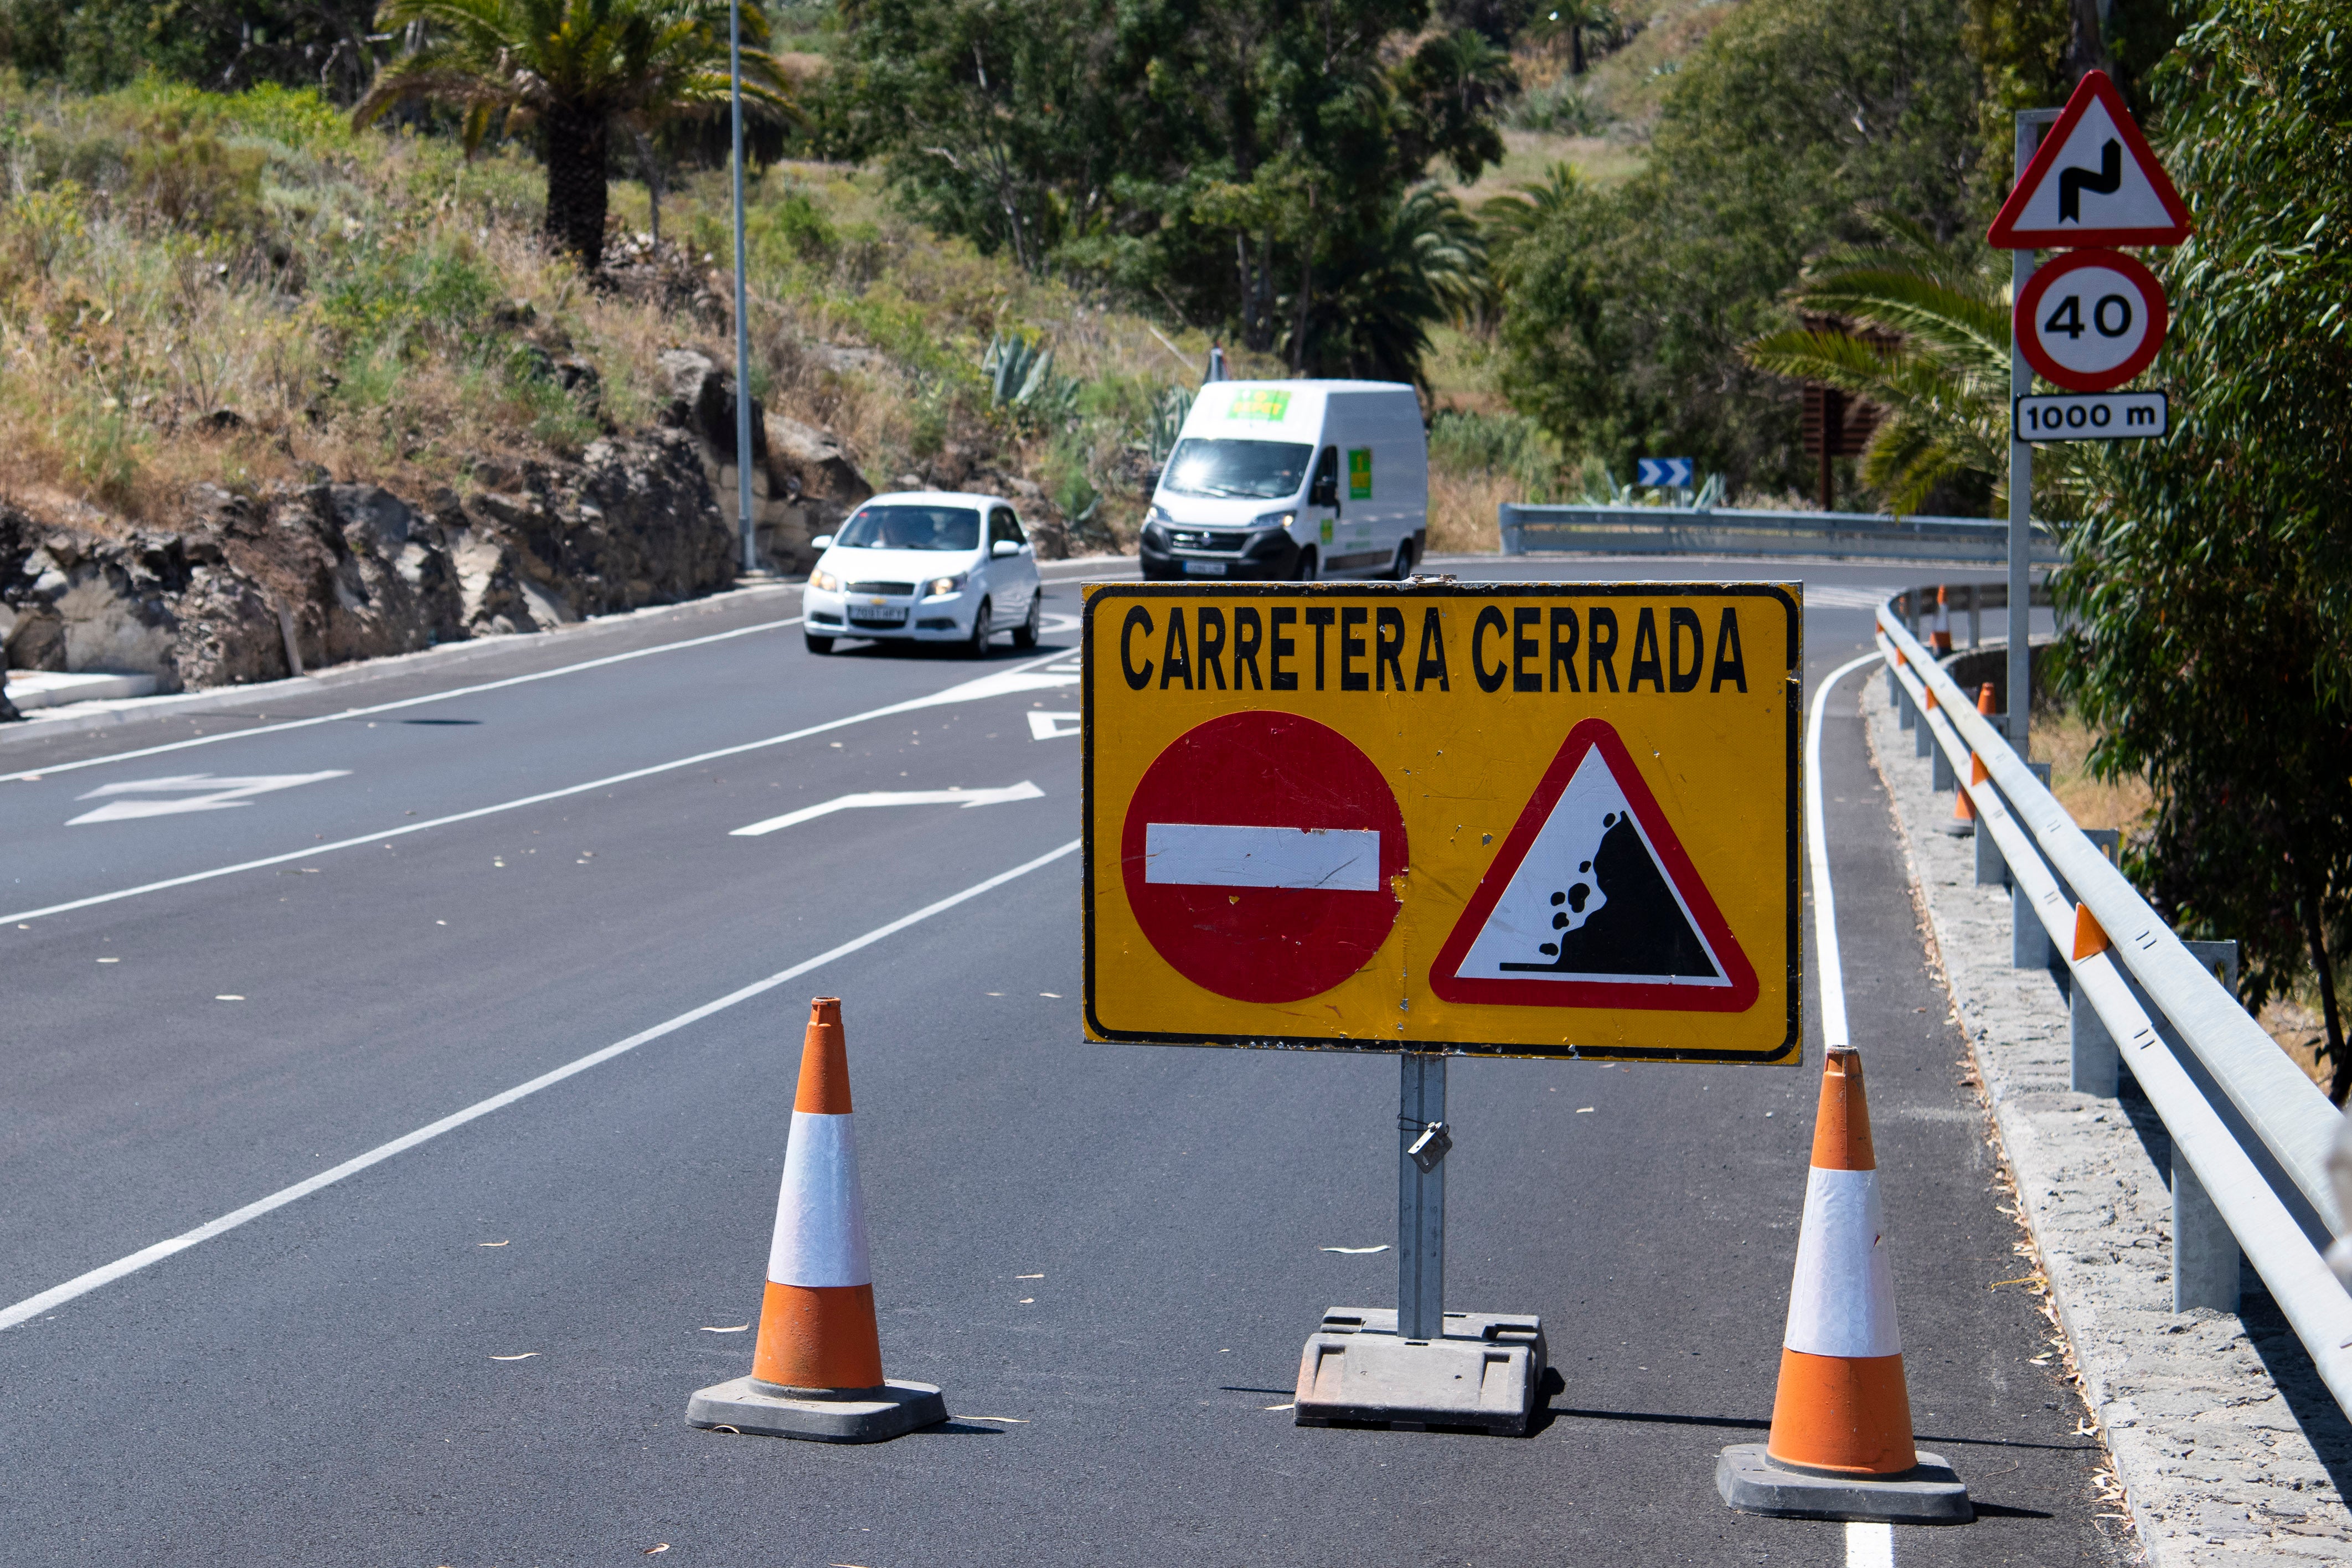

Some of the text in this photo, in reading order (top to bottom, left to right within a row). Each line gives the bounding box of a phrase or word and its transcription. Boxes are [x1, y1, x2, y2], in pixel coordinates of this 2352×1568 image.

[2044, 294, 2132, 339] 40
[2027, 404, 2154, 430] 1000 m
[1120, 605, 1748, 693] CARRETERA CERRADA
